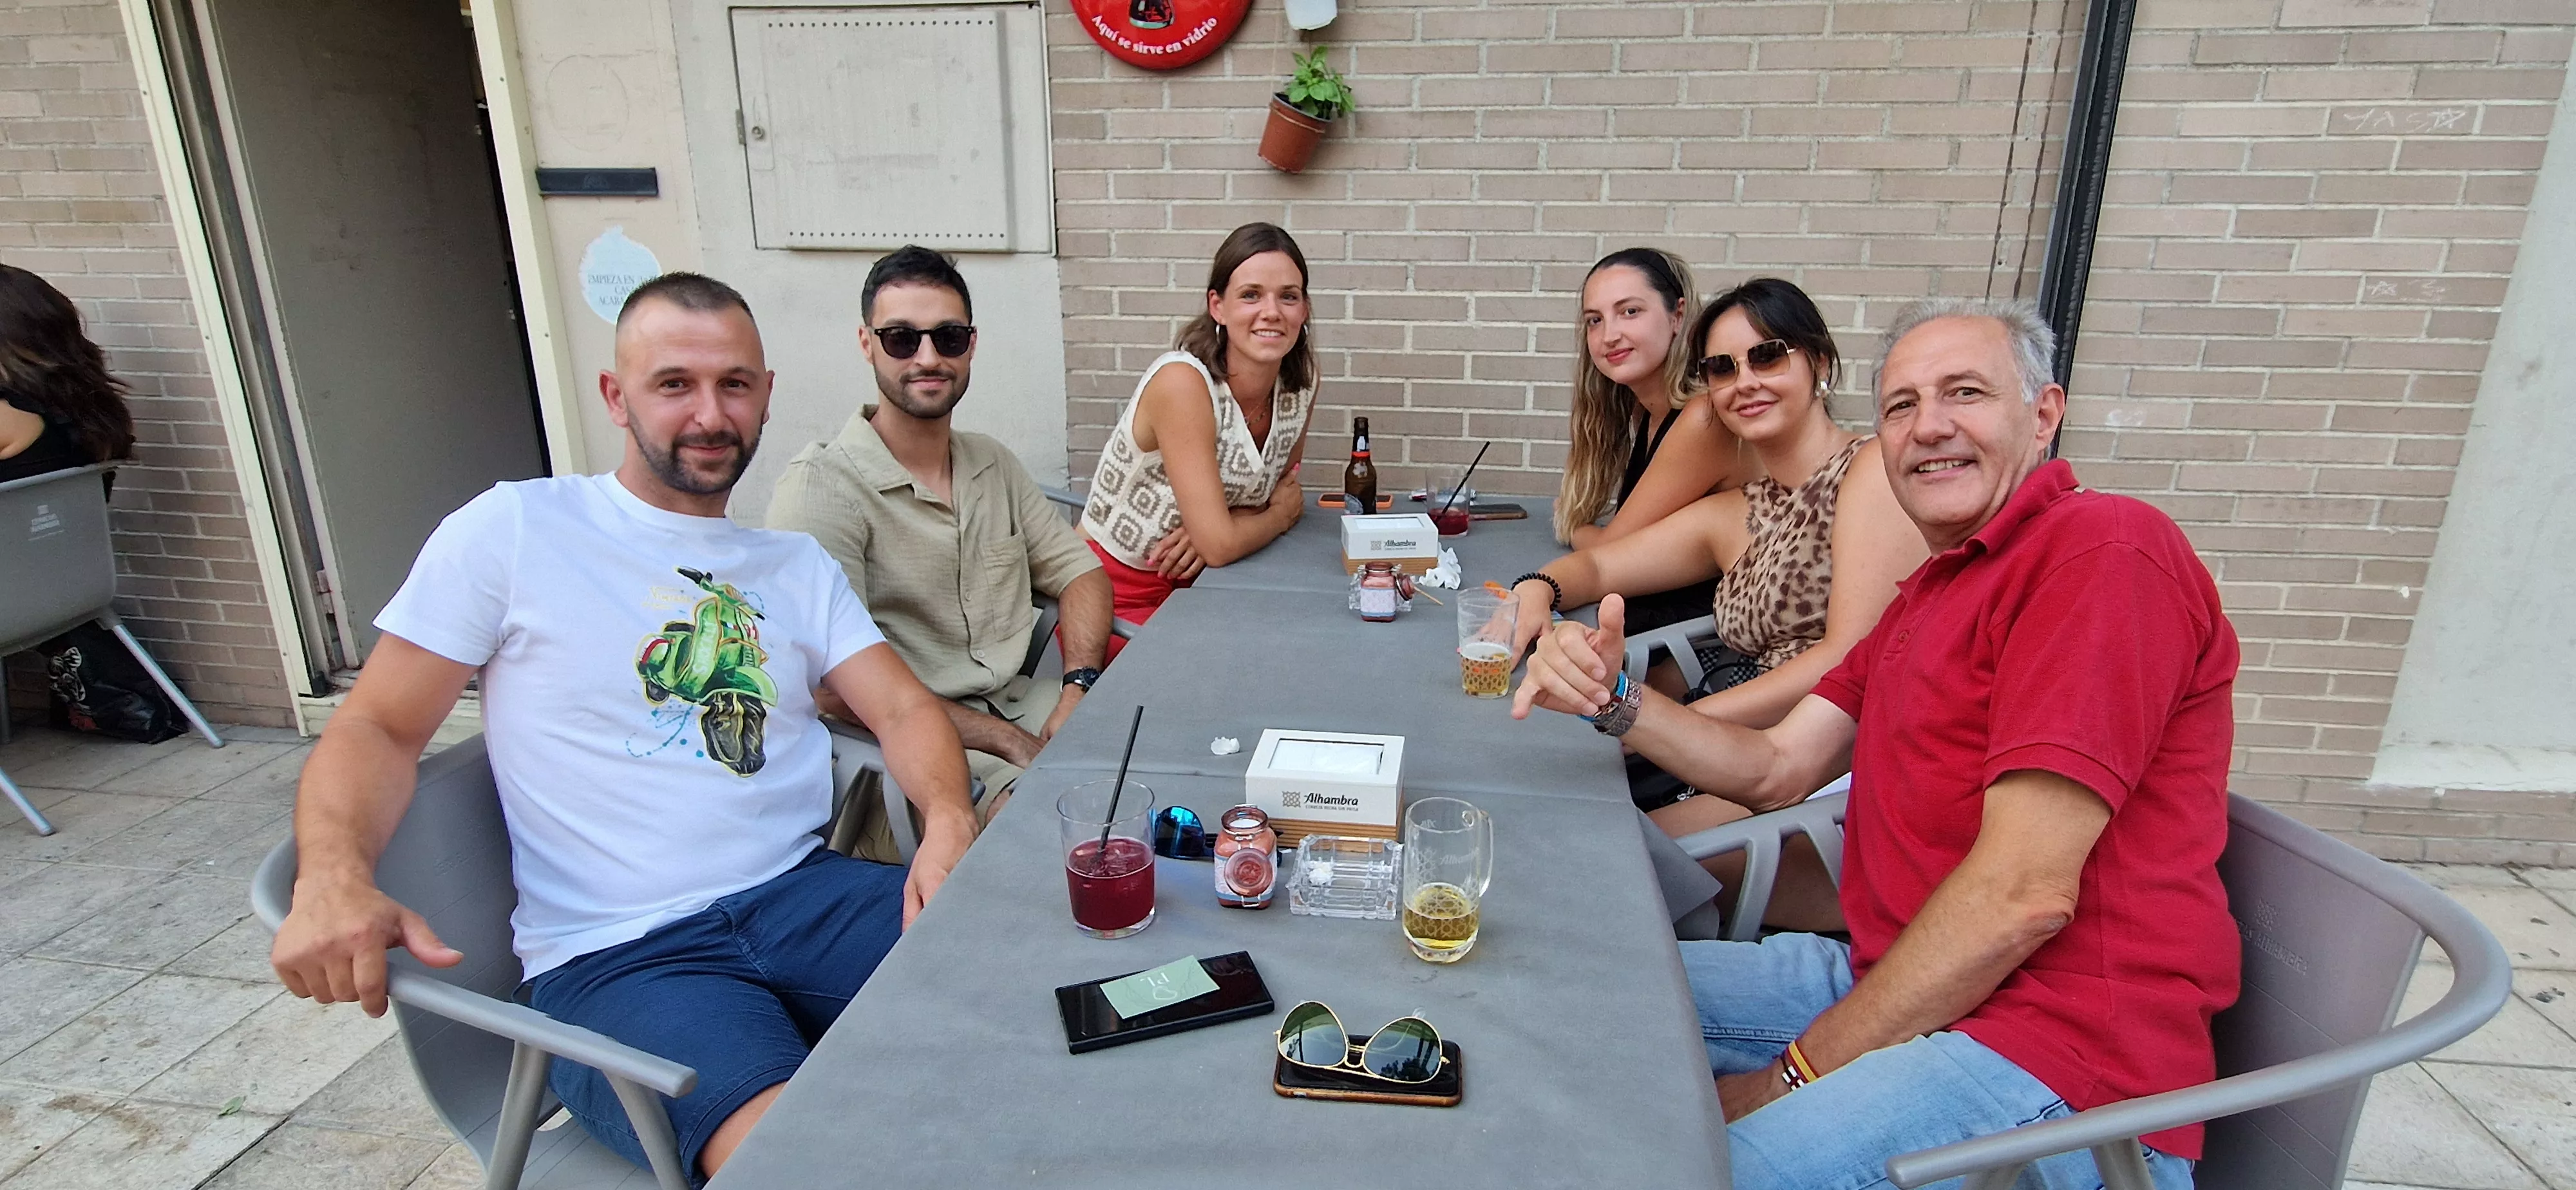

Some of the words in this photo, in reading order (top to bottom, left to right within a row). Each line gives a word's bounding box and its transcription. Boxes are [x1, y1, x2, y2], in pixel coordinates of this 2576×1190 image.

[1092, 15, 1118, 42] Aquí
[1117, 36, 1132, 49] se
[1132, 41, 1163, 54] sirve
[1166, 44, 1182, 53] en
[1182, 17, 1217, 46] vidrio
[588, 274, 622, 284] EMPIEZA
[624, 274, 635, 284] EN
[1303, 793, 1358, 806] Alhambra
